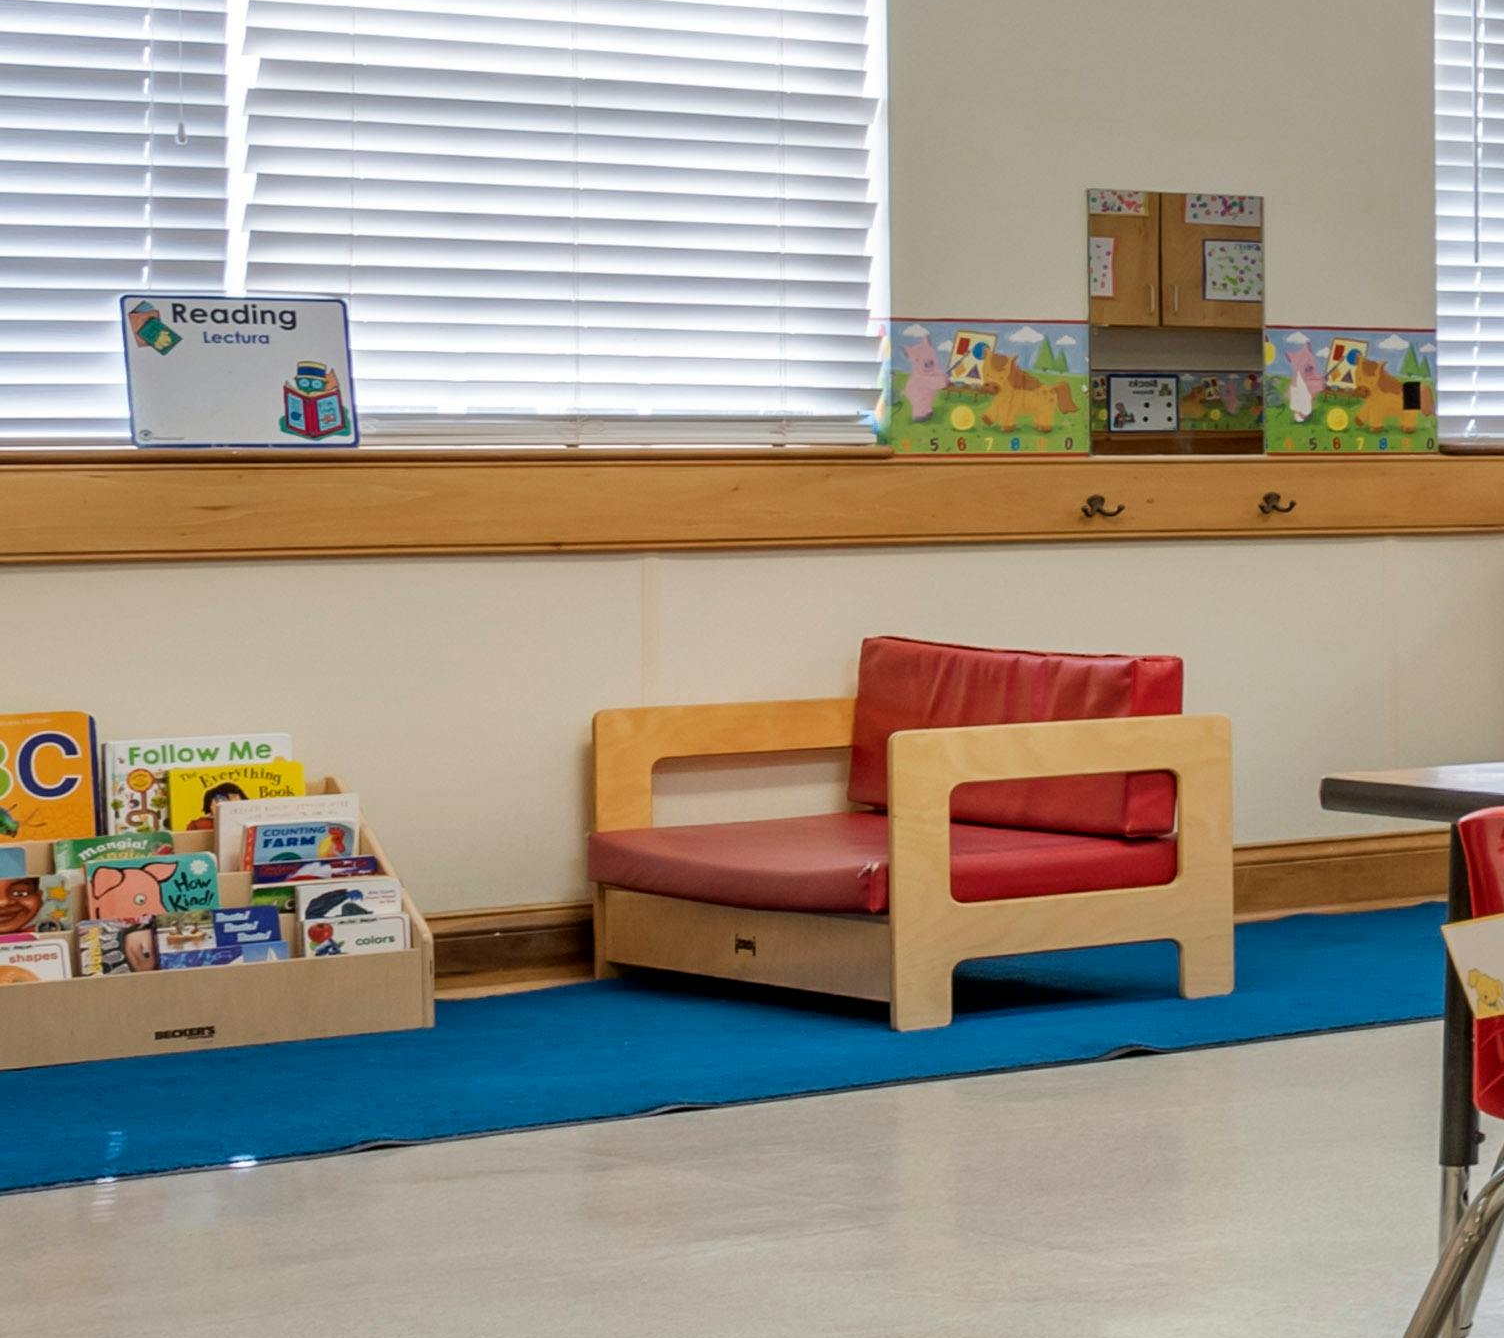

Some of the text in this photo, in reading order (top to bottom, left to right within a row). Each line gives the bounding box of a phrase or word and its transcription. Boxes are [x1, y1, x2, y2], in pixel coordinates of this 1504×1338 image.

[171, 303, 297, 331] Reading
[203, 331, 270, 345] Lectura
[128, 741, 272, 766] Follow Me
[180, 767, 282, 789] The Everything
[259, 785, 295, 798] Book
[262, 826, 326, 837] COUNTING
[262, 836, 316, 849] FARM
[173, 872, 212, 892] How
[168, 890, 215, 912] Kind!
[355, 935, 395, 946] colors
[8, 951, 58, 965] shapes
